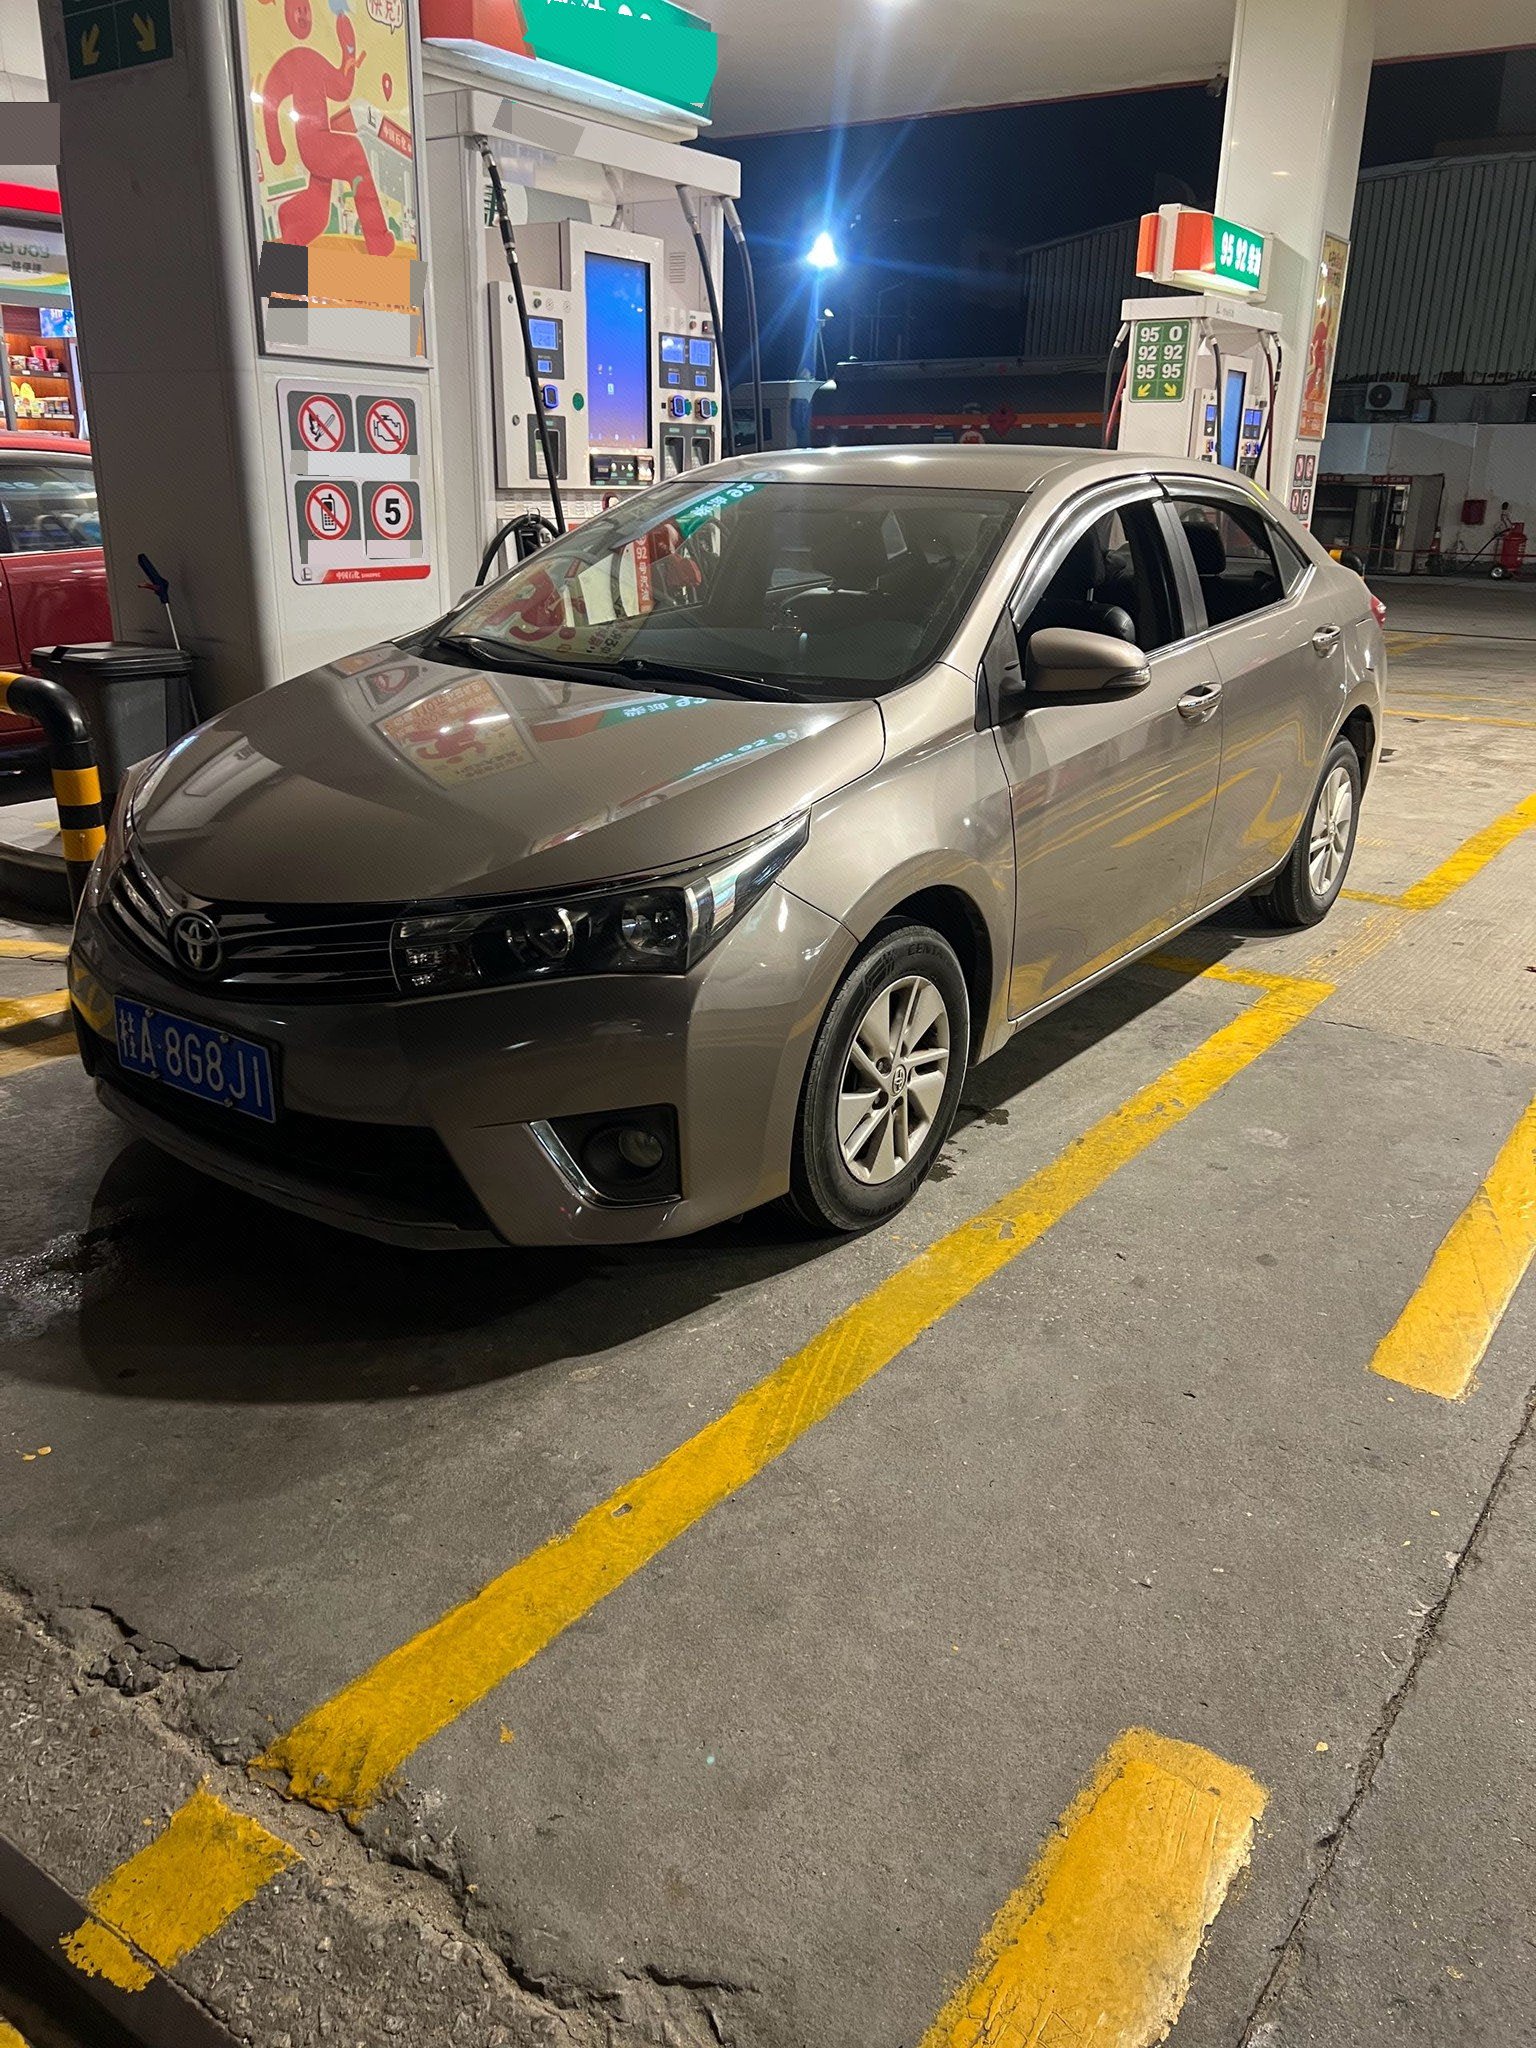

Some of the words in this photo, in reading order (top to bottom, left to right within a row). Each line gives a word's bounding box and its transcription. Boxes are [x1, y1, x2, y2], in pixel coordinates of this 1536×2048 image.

[1220, 231, 1235, 268] 95
[1235, 237, 1248, 273] 92
[385, 498, 401, 525] 5
